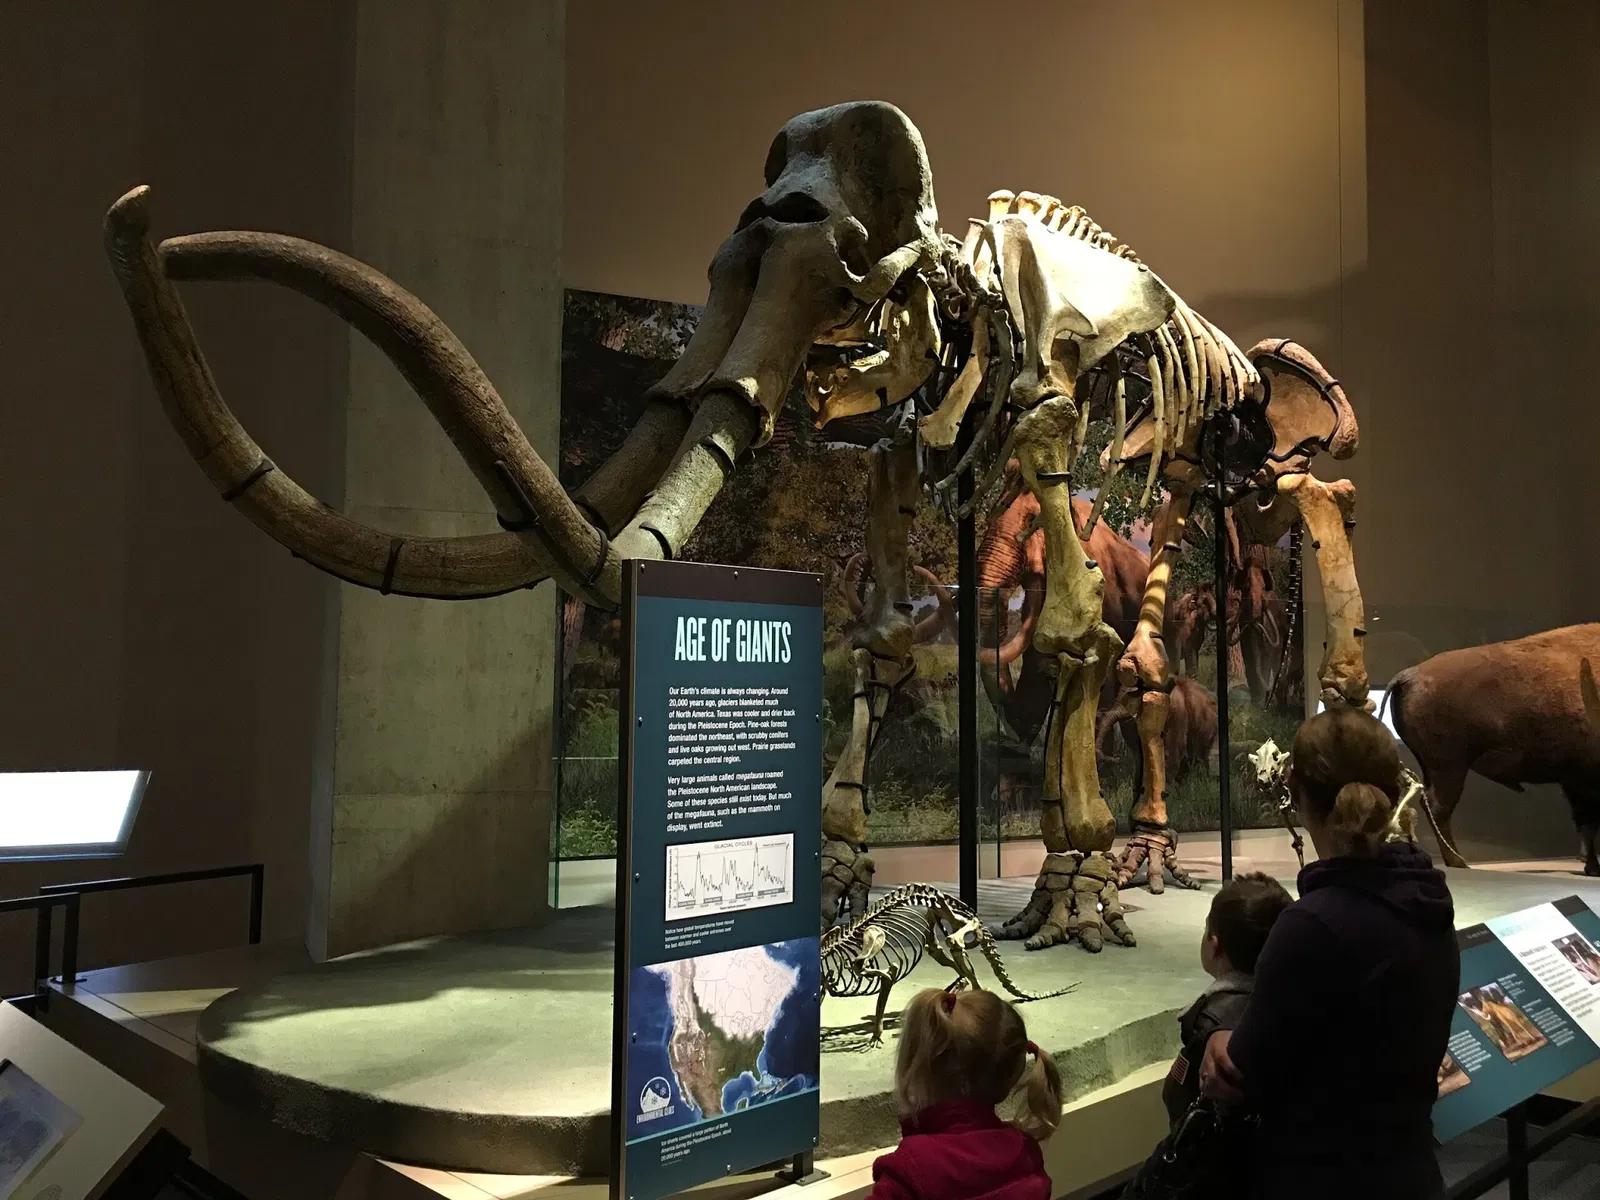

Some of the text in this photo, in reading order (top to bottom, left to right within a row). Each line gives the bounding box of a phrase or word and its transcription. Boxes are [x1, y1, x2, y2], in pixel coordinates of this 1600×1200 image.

[675, 617, 792, 663] AGE OF GIANTS
[669, 687, 679, 695] Our
[701, 687, 720, 695] climate
[727, 687, 745, 696] always
[746, 688, 770, 696] changing.
[669, 699, 688, 707] 20,000
[718, 699, 738, 707] glaciers
[676, 710, 691, 718] North
[669, 722, 686, 731] during
[729, 721, 746, 729] Epoch.
[669, 734, 697, 742] dominated
[709, 733, 735, 741] northeast,
[748, 732, 768, 740] scrubby
[680, 745, 689, 753] live
[705, 745, 726, 753] growing
[770, 742, 796, 751] grasslands
[668, 757, 692, 766] carpeted
[704, 756, 722, 764] central
[723, 755, 741, 764] region.
[668, 770, 783, 785] Very large animals called megafauna roamed
[668, 782, 777, 796] the Pleistocene North American landscape.
[667, 800, 683, 808] Some
[691, 798, 706, 806] these
[708, 797, 727, 806] species
[753, 794, 767, 803] today.
[667, 812, 673, 820] of
[674, 811, 683, 819] the
[685, 810, 716, 820] megafauna,
[717, 808, 730, 816] such
[748, 805, 773, 813] mammoth
[667, 820, 723, 832] display, went extinct.
